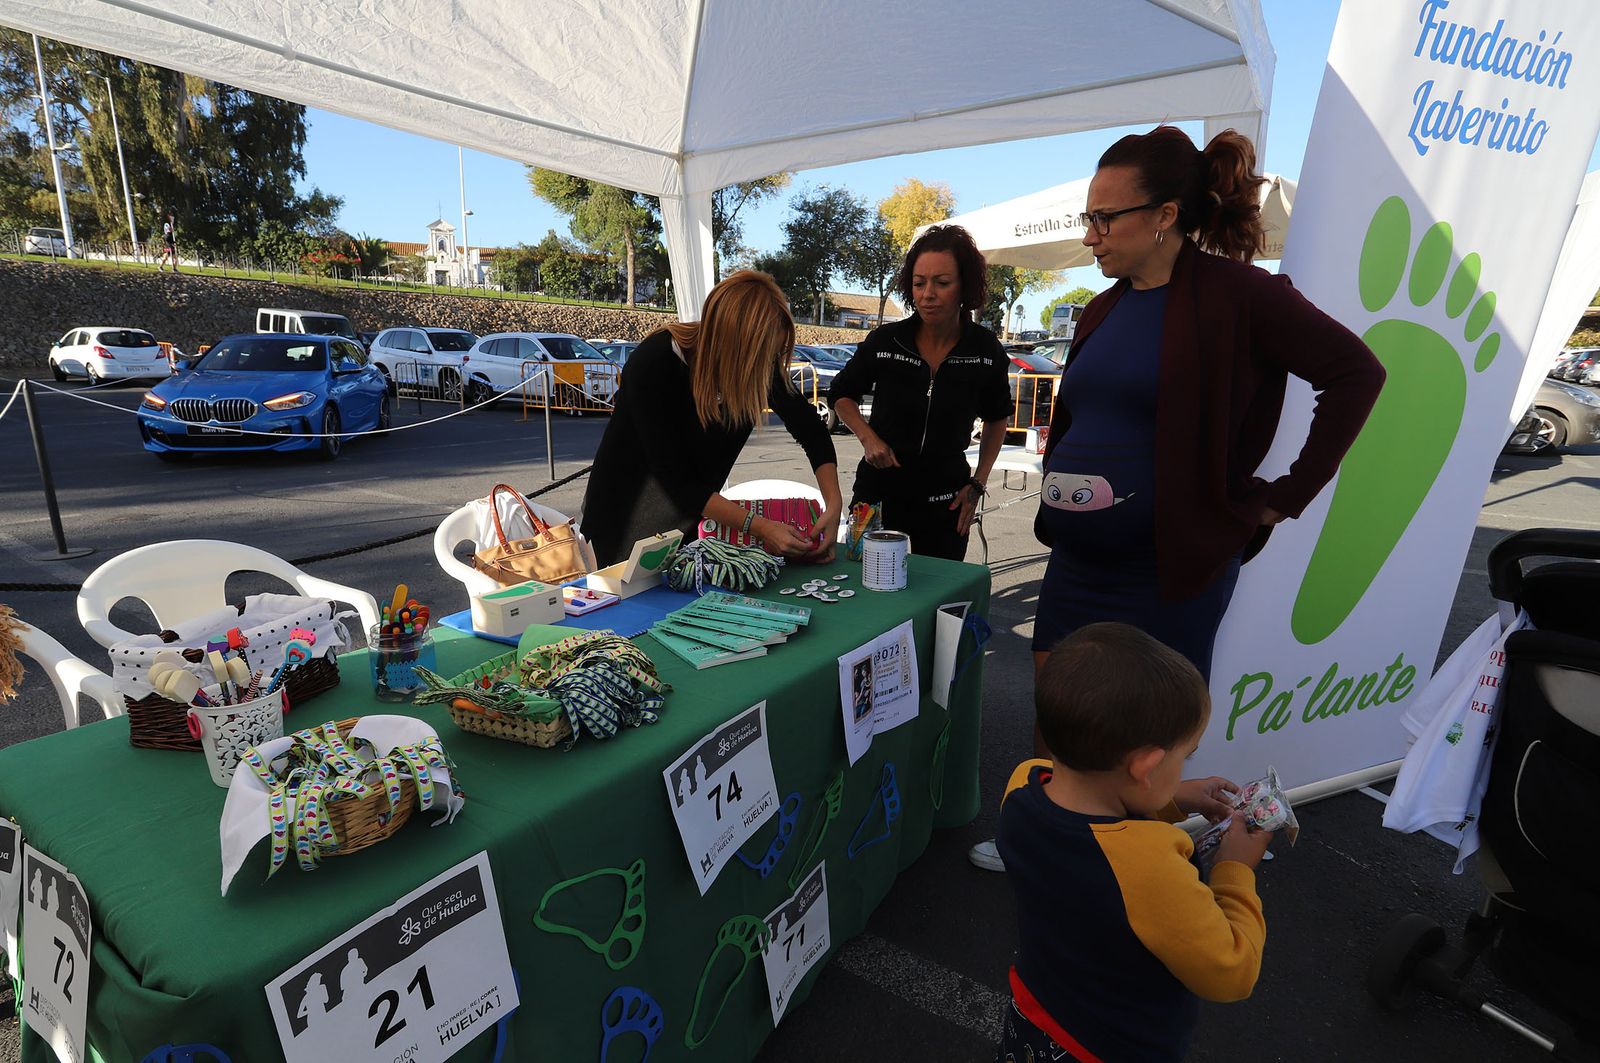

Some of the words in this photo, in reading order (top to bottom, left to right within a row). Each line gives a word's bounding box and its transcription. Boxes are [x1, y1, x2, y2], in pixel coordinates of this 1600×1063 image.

[1414, 0, 1573, 90] Fundación
[1408, 80, 1550, 156] Laberinto
[1015, 219, 1060, 237] Estrella
[707, 770, 743, 822] 74
[743, 800, 769, 828] HUELVA
[422, 900, 442, 919] Que
[445, 890, 462, 906] sea
[424, 914, 437, 930] de
[440, 894, 477, 920] Huelva
[782, 922, 806, 962] 71
[53, 936, 75, 1004] 72
[368, 964, 436, 1049] 21
[440, 1001, 494, 1046] HUELVA
